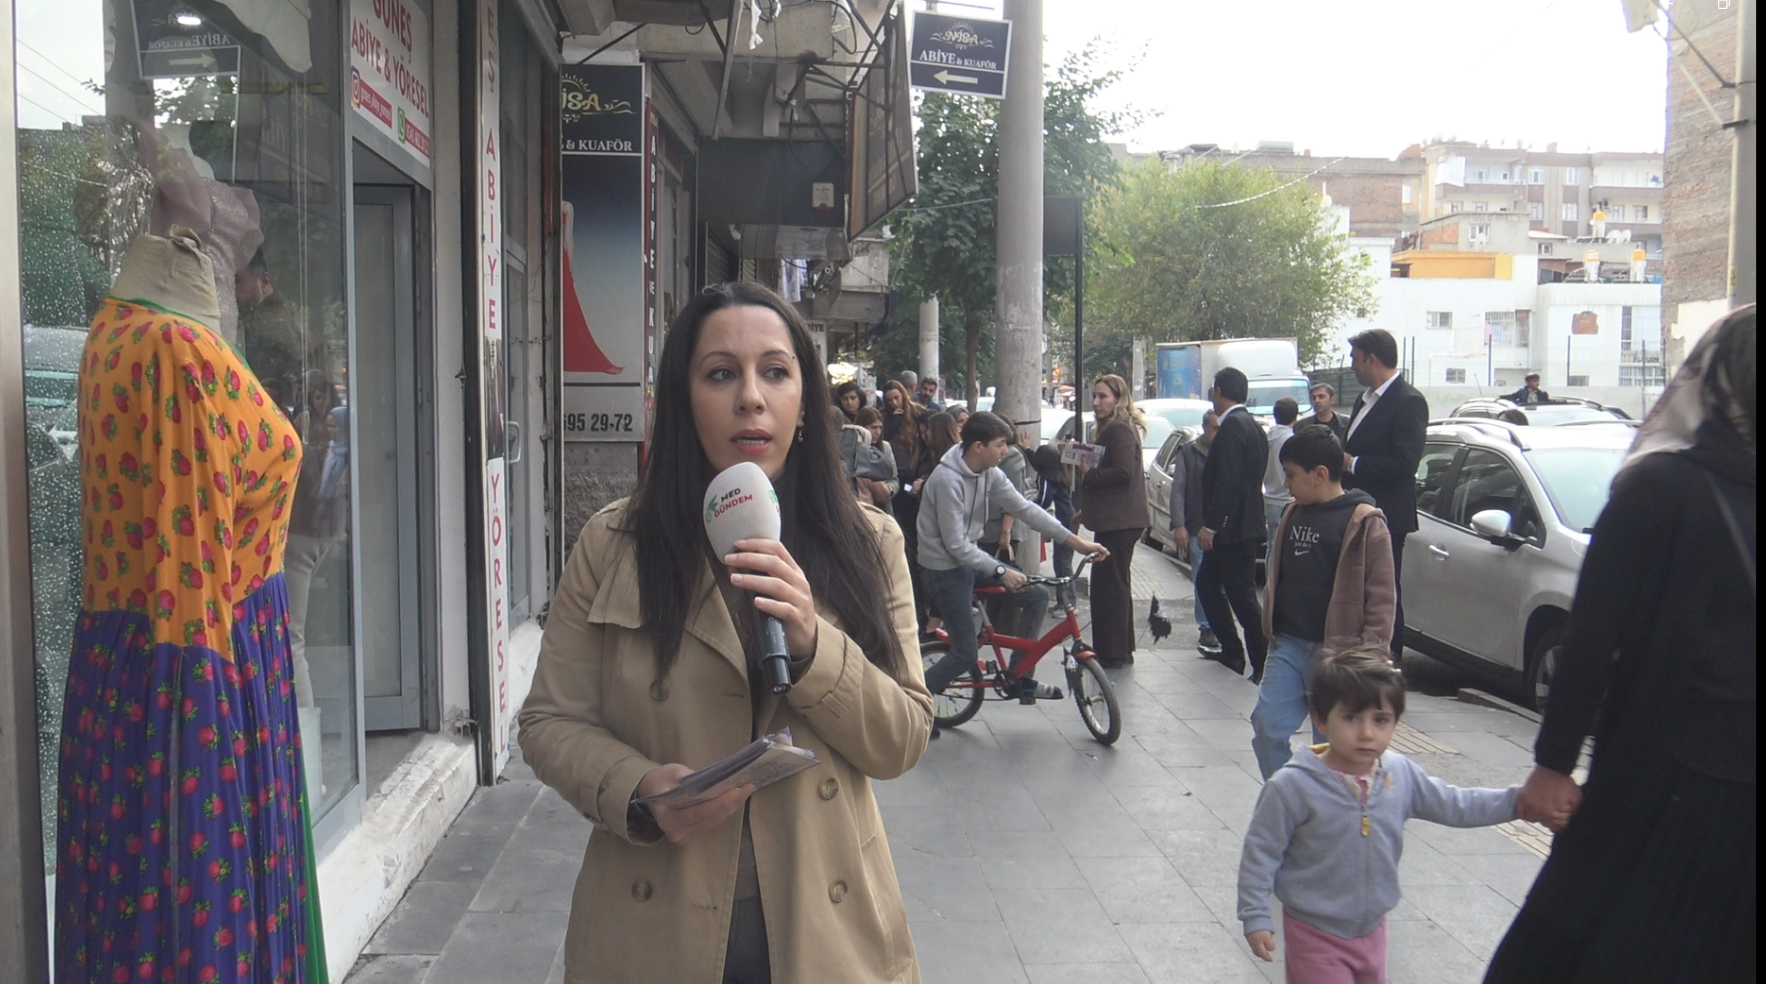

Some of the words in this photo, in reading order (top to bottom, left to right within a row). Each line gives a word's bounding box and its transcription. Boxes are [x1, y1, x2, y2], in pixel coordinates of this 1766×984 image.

[351, 17, 381, 74] ABİYE
[384, 48, 391, 83] &
[393, 56, 428, 118] YÖRESEL
[919, 49, 957, 66] ABİYE
[964, 58, 997, 71] KUAFÖR
[566, 139, 576, 150] &
[578, 138, 633, 152] KUAFÖR
[486, 128, 497, 330] ABİYE
[714, 495, 753, 517] GÜNDEM
[721, 488, 741, 502] MED
[1290, 526, 1319, 542] Nike
[491, 473, 507, 752] YÖRESEL
